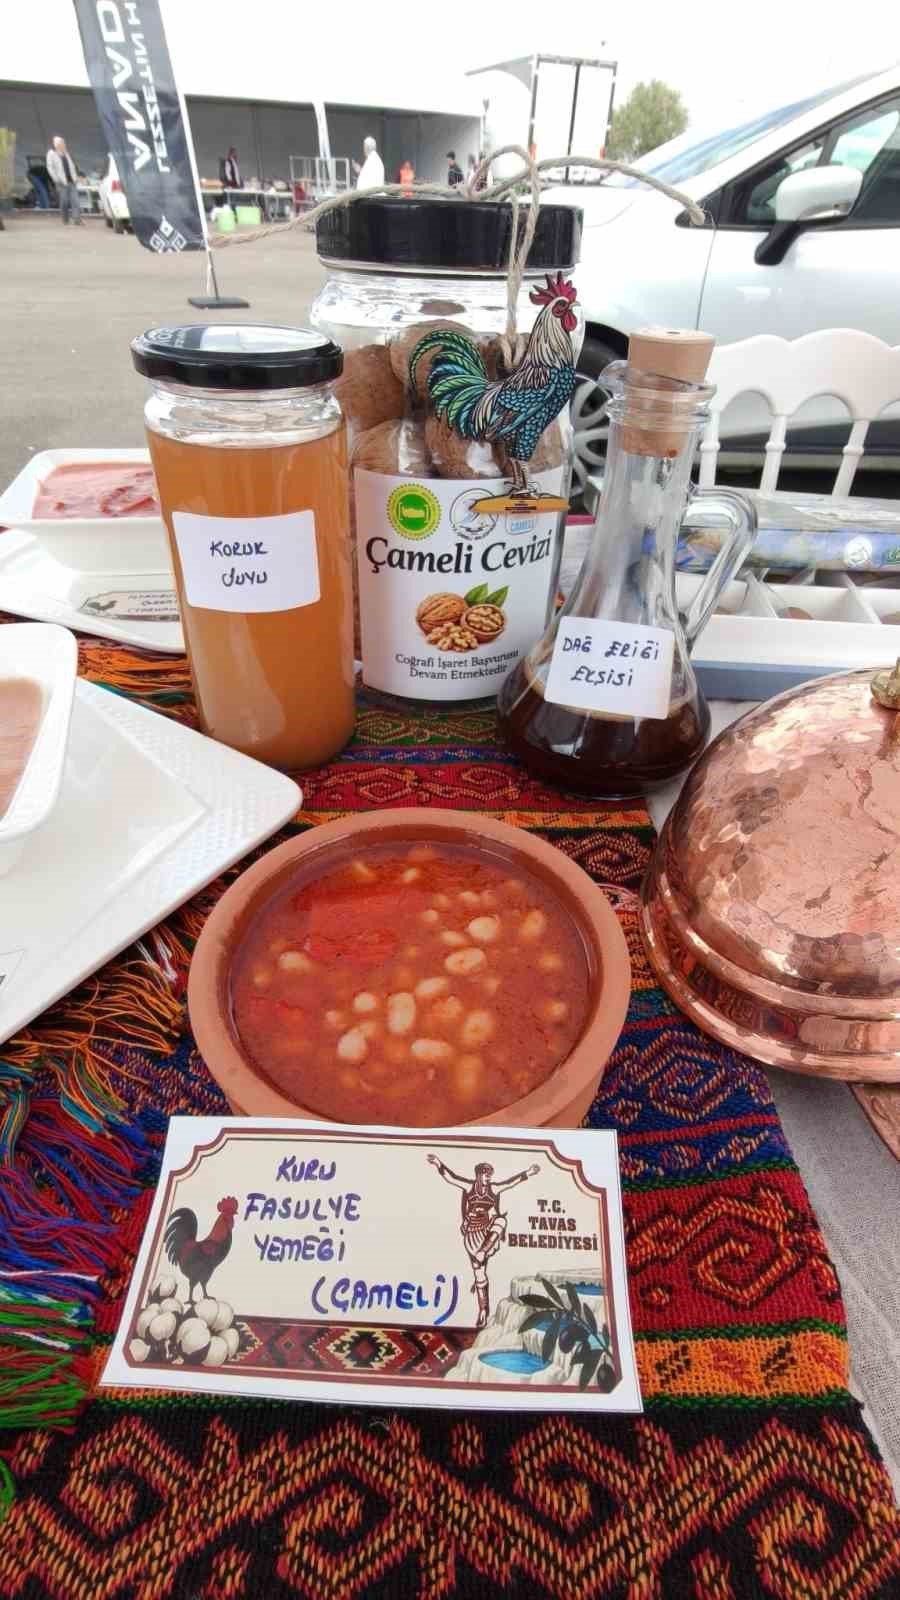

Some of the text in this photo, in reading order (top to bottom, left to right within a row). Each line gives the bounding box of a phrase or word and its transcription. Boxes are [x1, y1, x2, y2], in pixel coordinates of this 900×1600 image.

[210, 541, 268, 557] KORUK
[366, 529, 552, 574] Çameli Cevizi
[562, 635, 593, 653] DAĞ
[395, 653, 434, 668] Coğrafi
[438, 656, 468, 669] İşaret
[409, 663, 508, 680] Devam Etmektedir
[275, 1155, 337, 1183] KURU
[244, 1192, 361, 1222] FASULYE
[537, 1199, 566, 1214] T.C.
[528, 1215, 577, 1232] TAVAS
[254, 1226, 345, 1263] YEMEĞİ
[508, 1231, 598, 1251] BELEDİYESİ
[311, 1274, 459, 1325] (ÇAMELİ)
